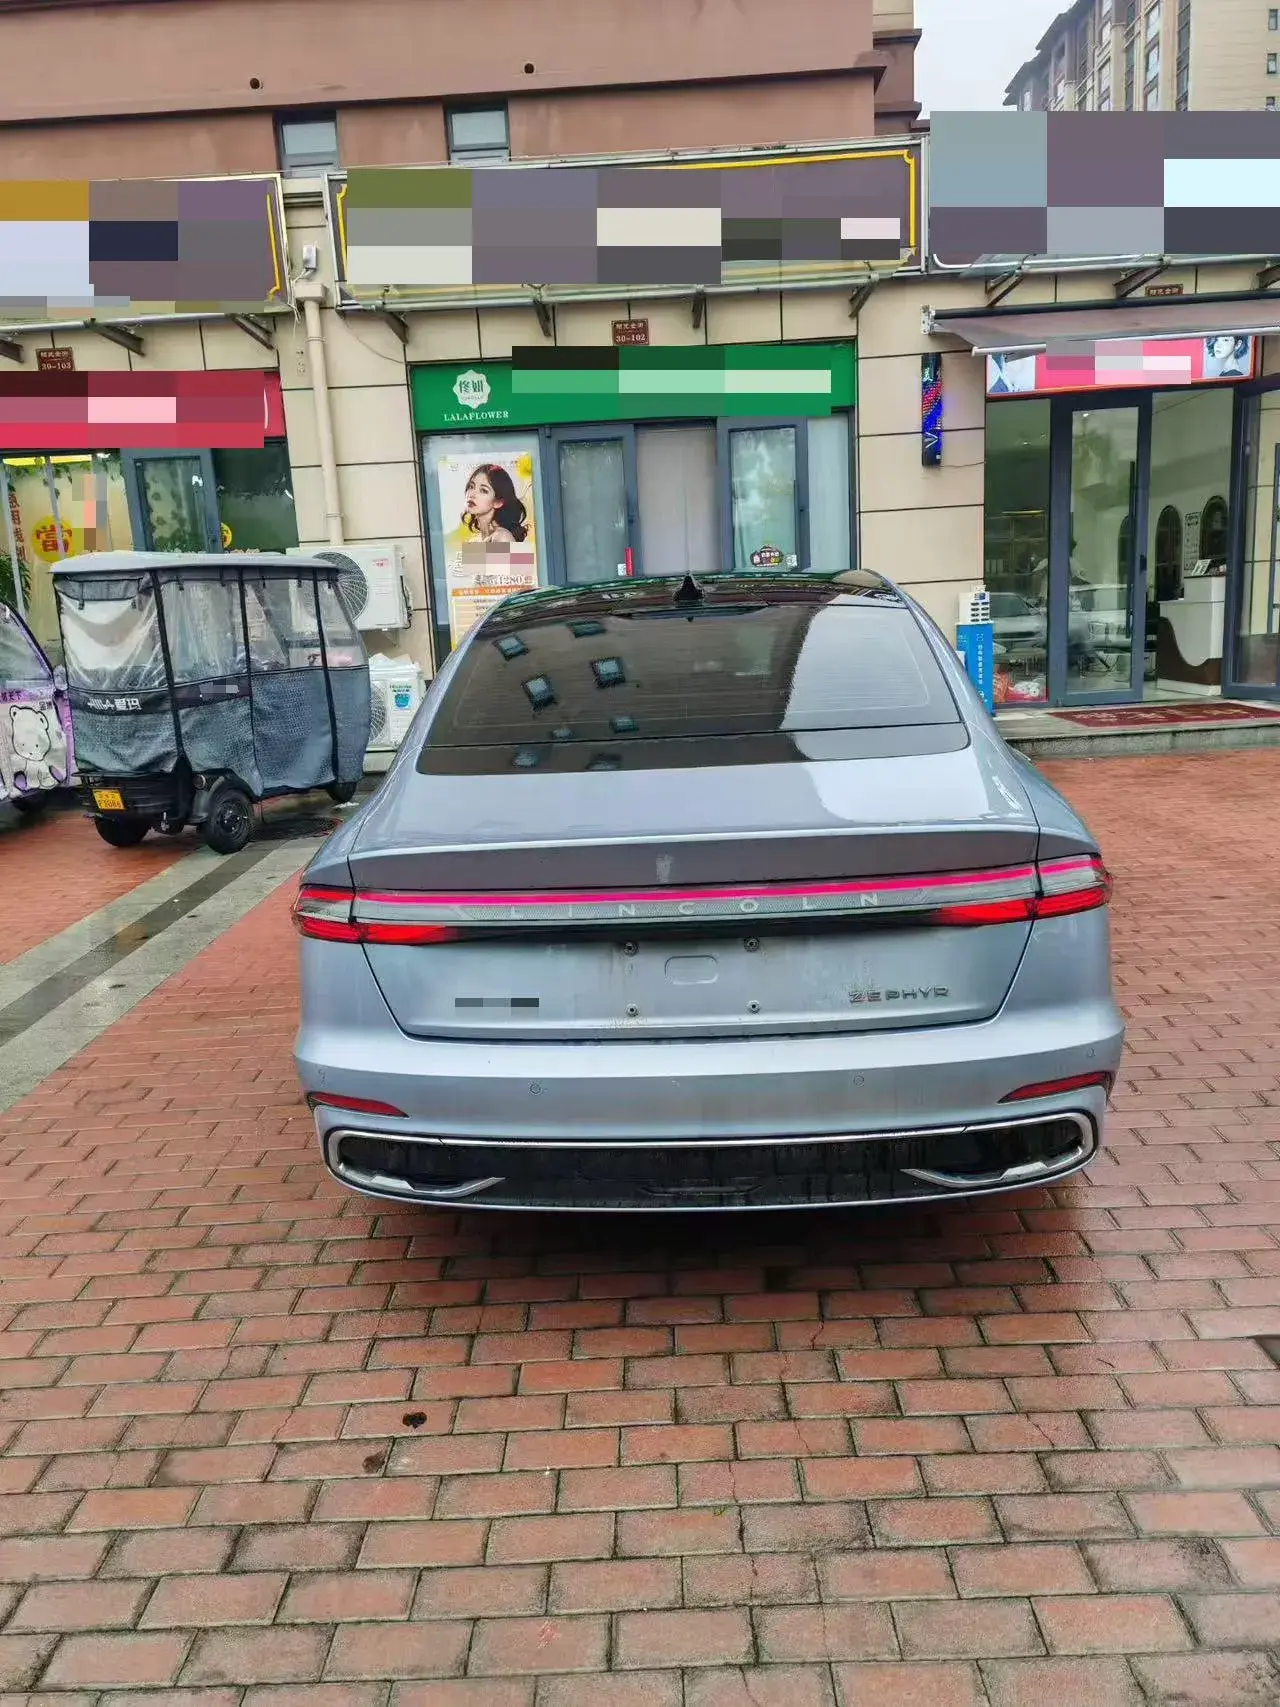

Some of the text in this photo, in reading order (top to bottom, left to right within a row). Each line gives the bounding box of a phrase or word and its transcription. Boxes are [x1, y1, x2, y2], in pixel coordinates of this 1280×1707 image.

[615, 333, 646, 342] 30-102
[443, 410, 509, 422] LALAFLOWER
[509, 891, 879, 919] LINCOLN
[848, 985, 950, 1004] ZEPHYR
